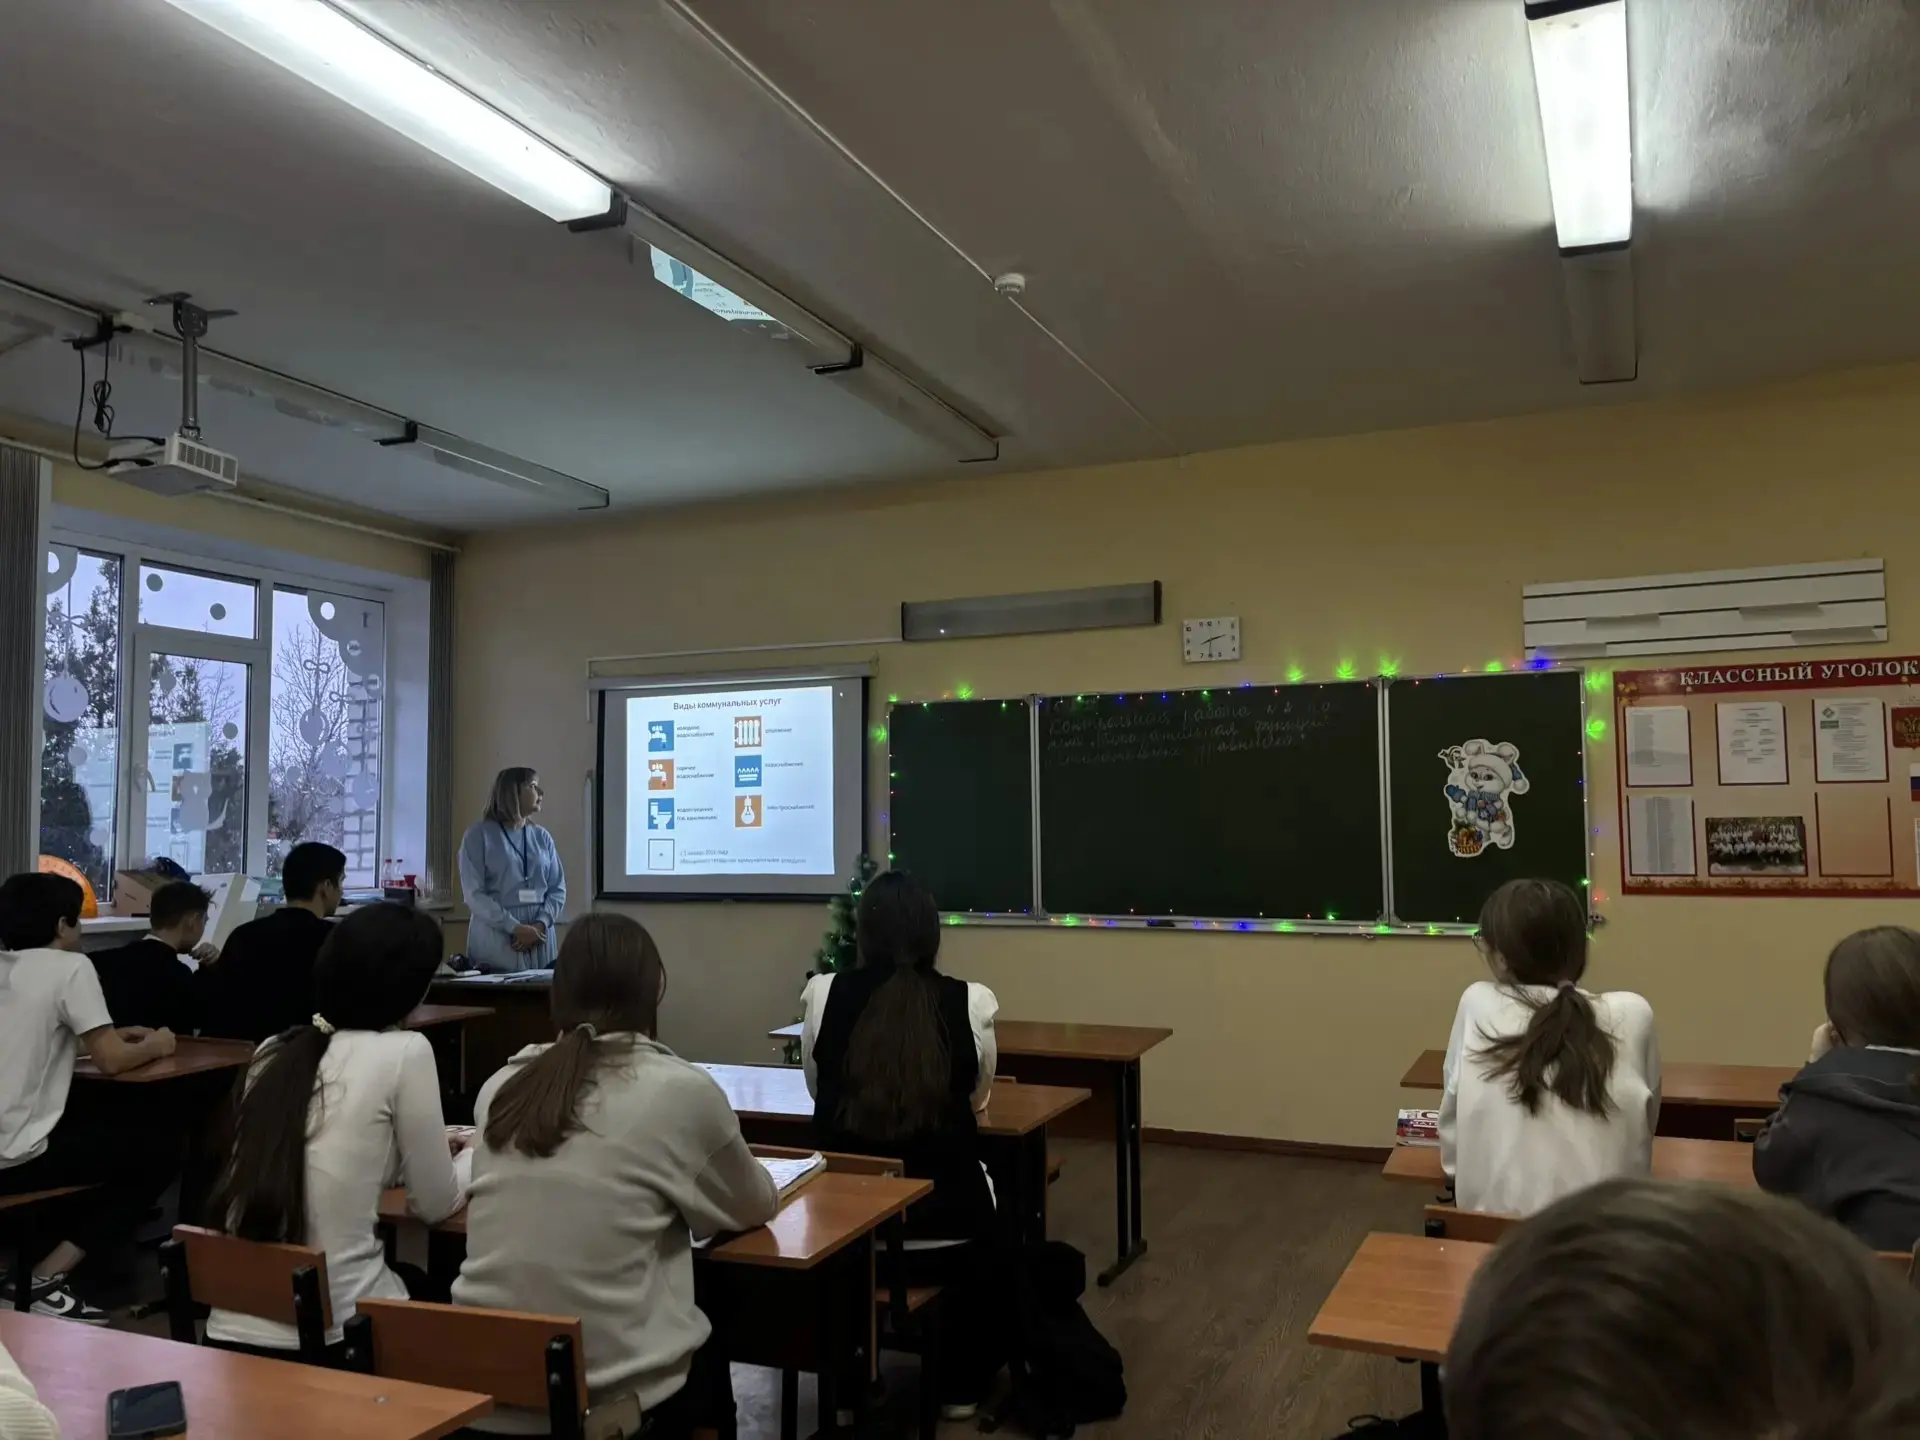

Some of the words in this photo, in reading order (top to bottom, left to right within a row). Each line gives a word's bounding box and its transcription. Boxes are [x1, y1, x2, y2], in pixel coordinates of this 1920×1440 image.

[1679, 662, 1813, 686] КЛАССНЫЙ
[1821, 660, 1919, 678] УГОЛОК
[673, 701, 696, 711] Виды
[697, 699, 758, 711] коммунальных
[759, 697, 782, 707] услуг
